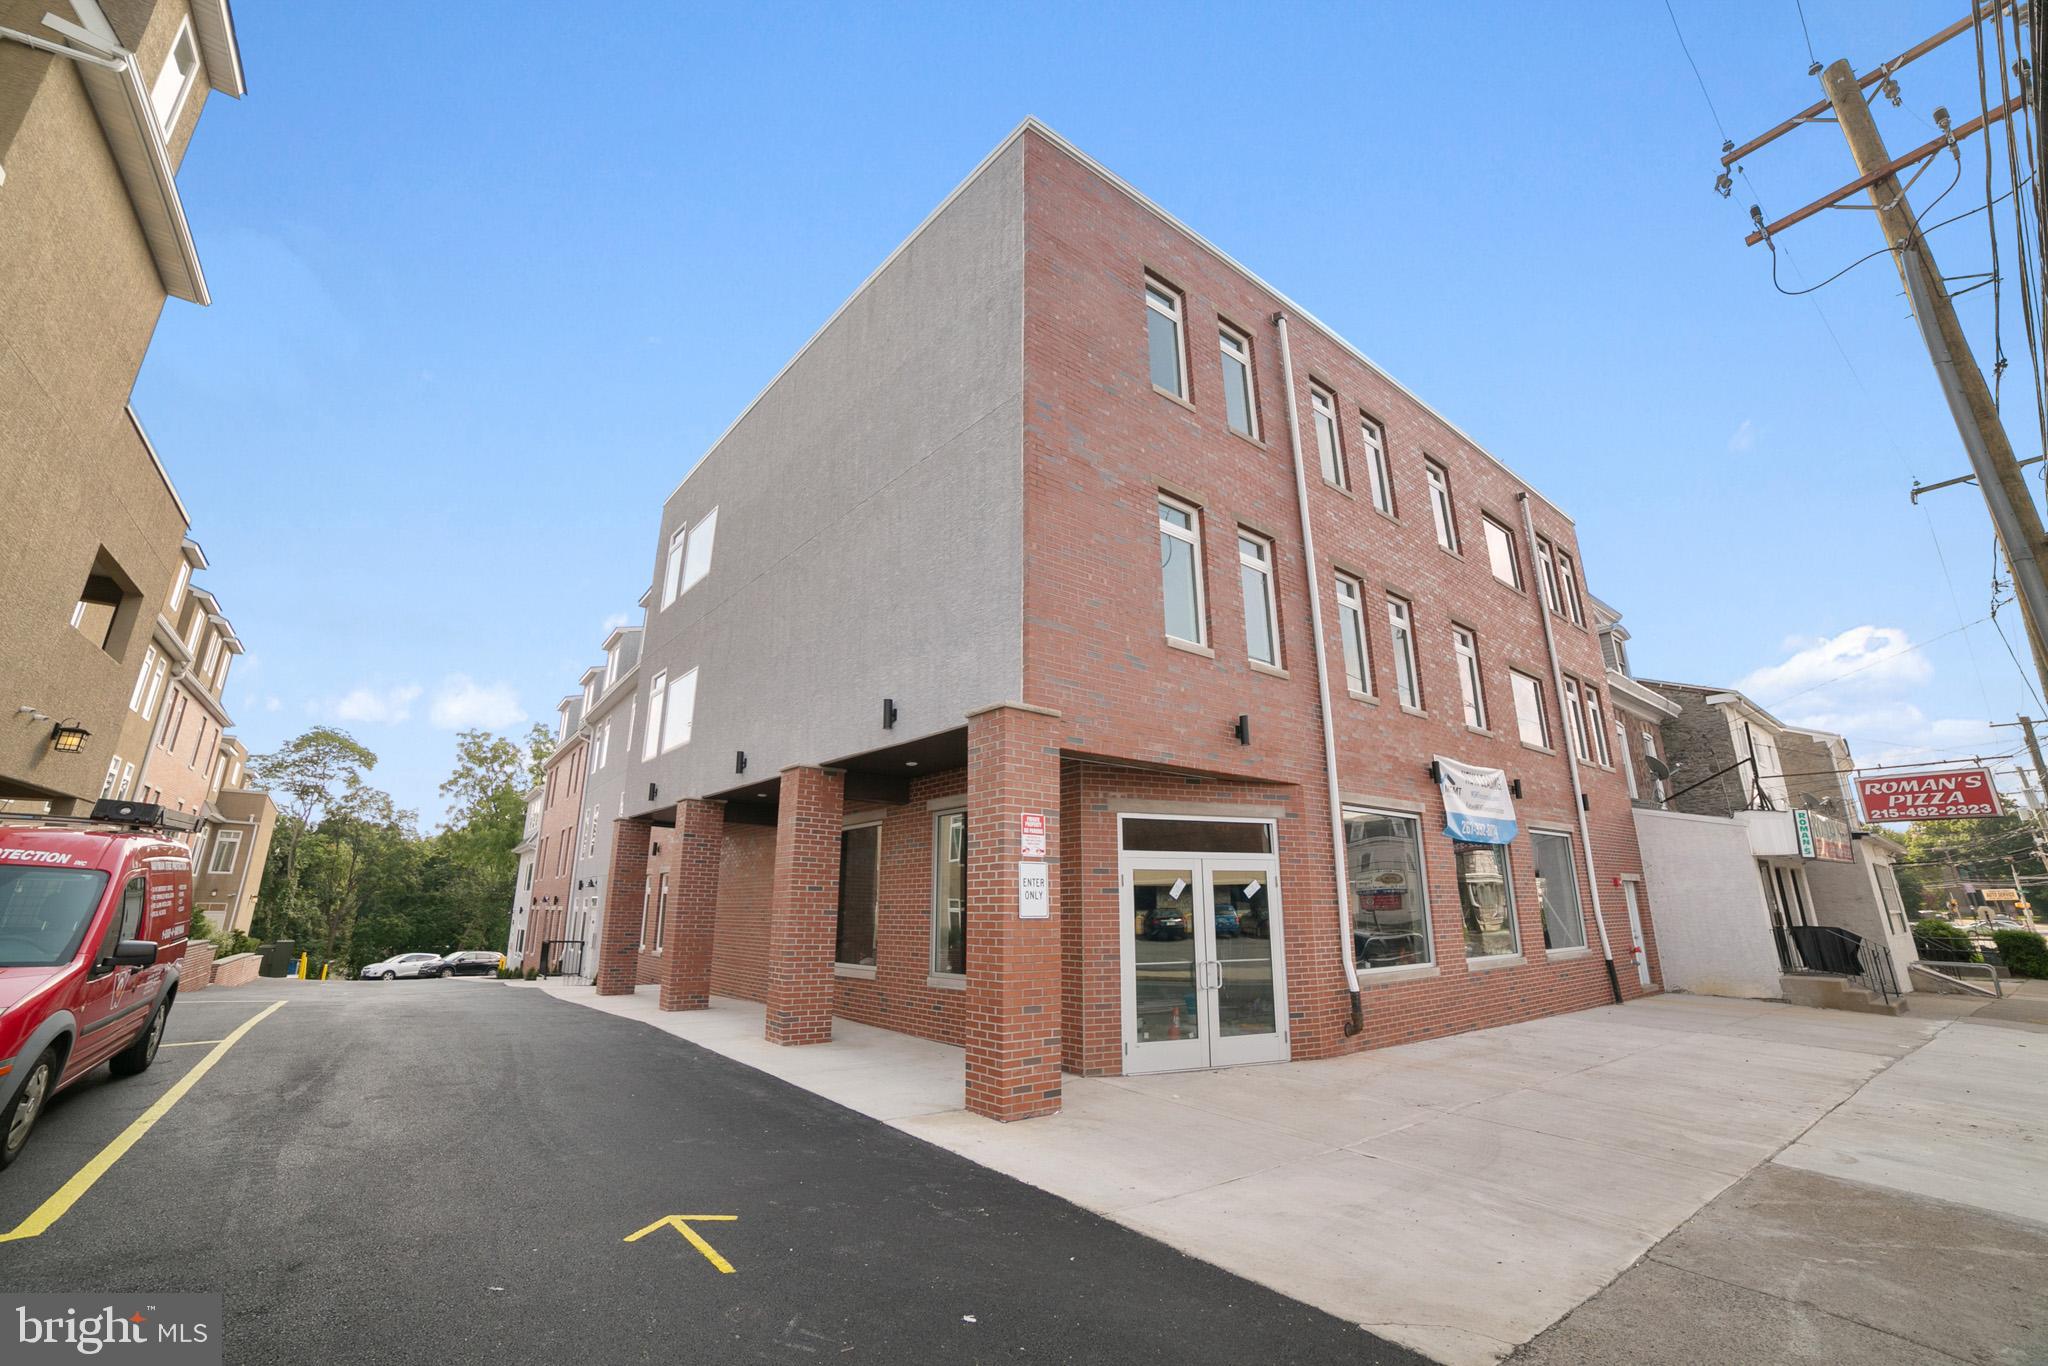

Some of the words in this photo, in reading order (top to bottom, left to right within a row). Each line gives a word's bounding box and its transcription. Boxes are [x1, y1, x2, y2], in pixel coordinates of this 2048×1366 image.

[1865, 775, 1982, 795] ROMAN'S
[1888, 791, 1965, 807] PIZZA
[1871, 803, 1992, 819] 215-482-2323
[0, 847, 72, 864] TECTION
[1023, 878, 1045, 887] ENTER
[1025, 891, 1043, 900] ONLY
